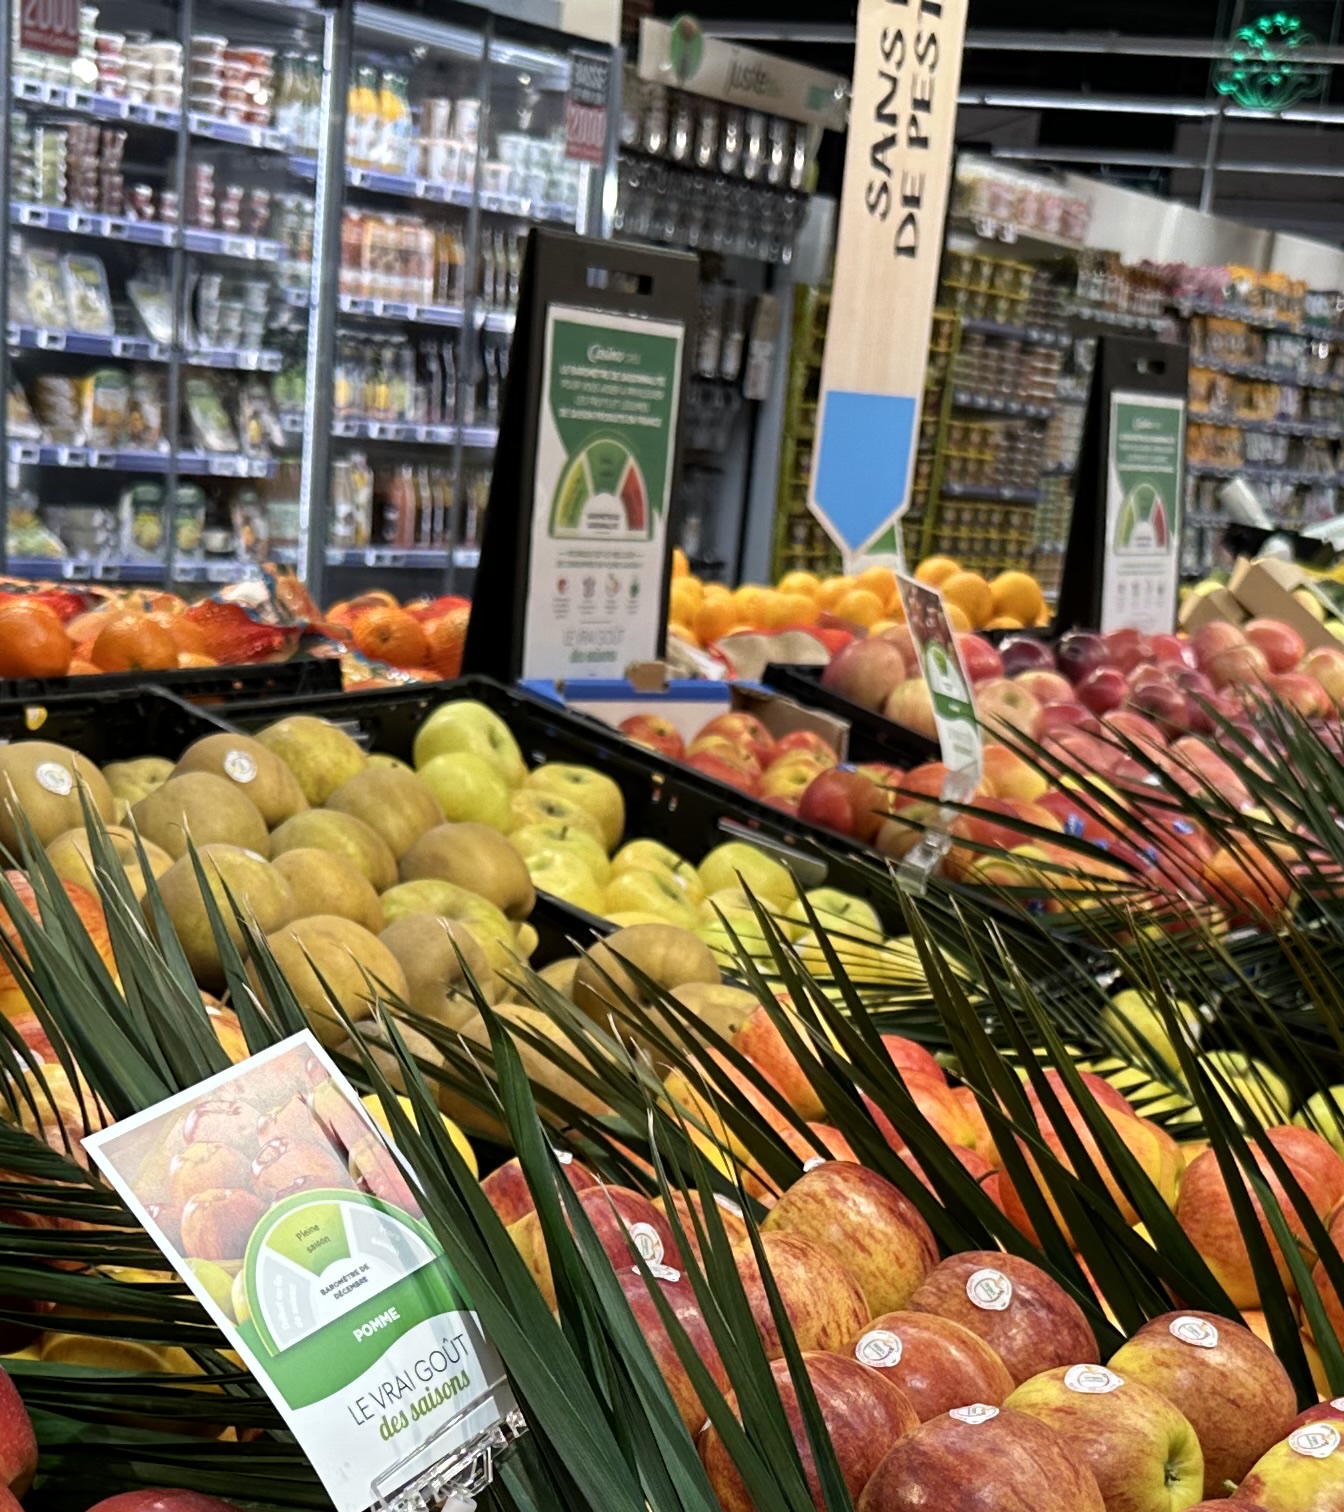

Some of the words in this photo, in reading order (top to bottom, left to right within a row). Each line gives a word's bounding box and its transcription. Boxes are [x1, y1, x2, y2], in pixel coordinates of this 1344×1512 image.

[865, 26, 908, 222] SANS
[894, 168, 927, 259] DE
[305, 1236, 332, 1255] saison
[352, 1306, 401, 1343] POMME
[346, 1396, 375, 1427] LE
[367, 1369, 417, 1410] VRAI
[413, 1333, 470, 1383] GOÛT
[378, 1411, 410, 1442] des
[410, 1367, 472, 1422] saisons
